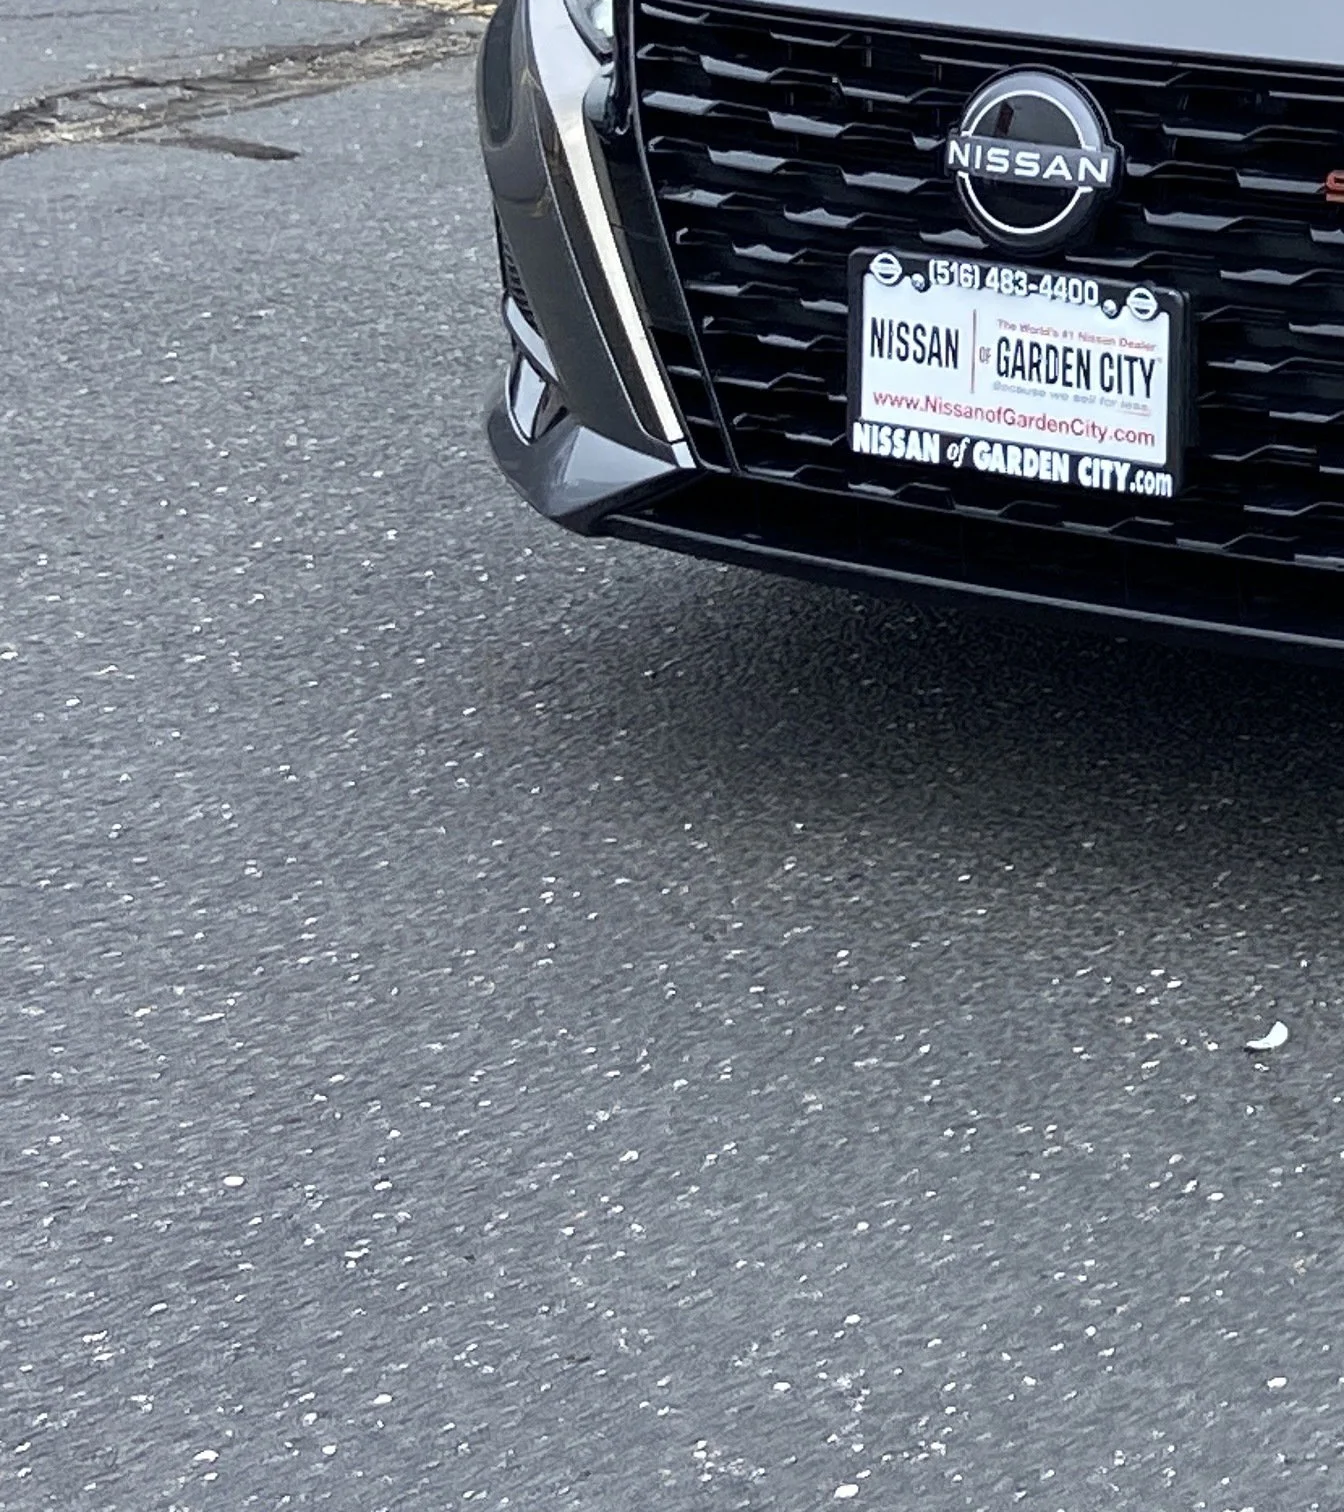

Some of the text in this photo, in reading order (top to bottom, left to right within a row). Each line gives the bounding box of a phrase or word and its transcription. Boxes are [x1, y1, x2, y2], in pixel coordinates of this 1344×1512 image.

[947, 141, 1110, 184] NISSAN
[929, 259, 1099, 307] (516) 483-4400
[870, 316, 960, 370] NISSAN
[996, 335, 1091, 390] GARDEN
[1100, 351, 1155, 399] CITY
[873, 392, 1156, 447] www.NissanofGardenCity.com
[852, 422, 1173, 498] NISSAN of GARDEN CITY.com
